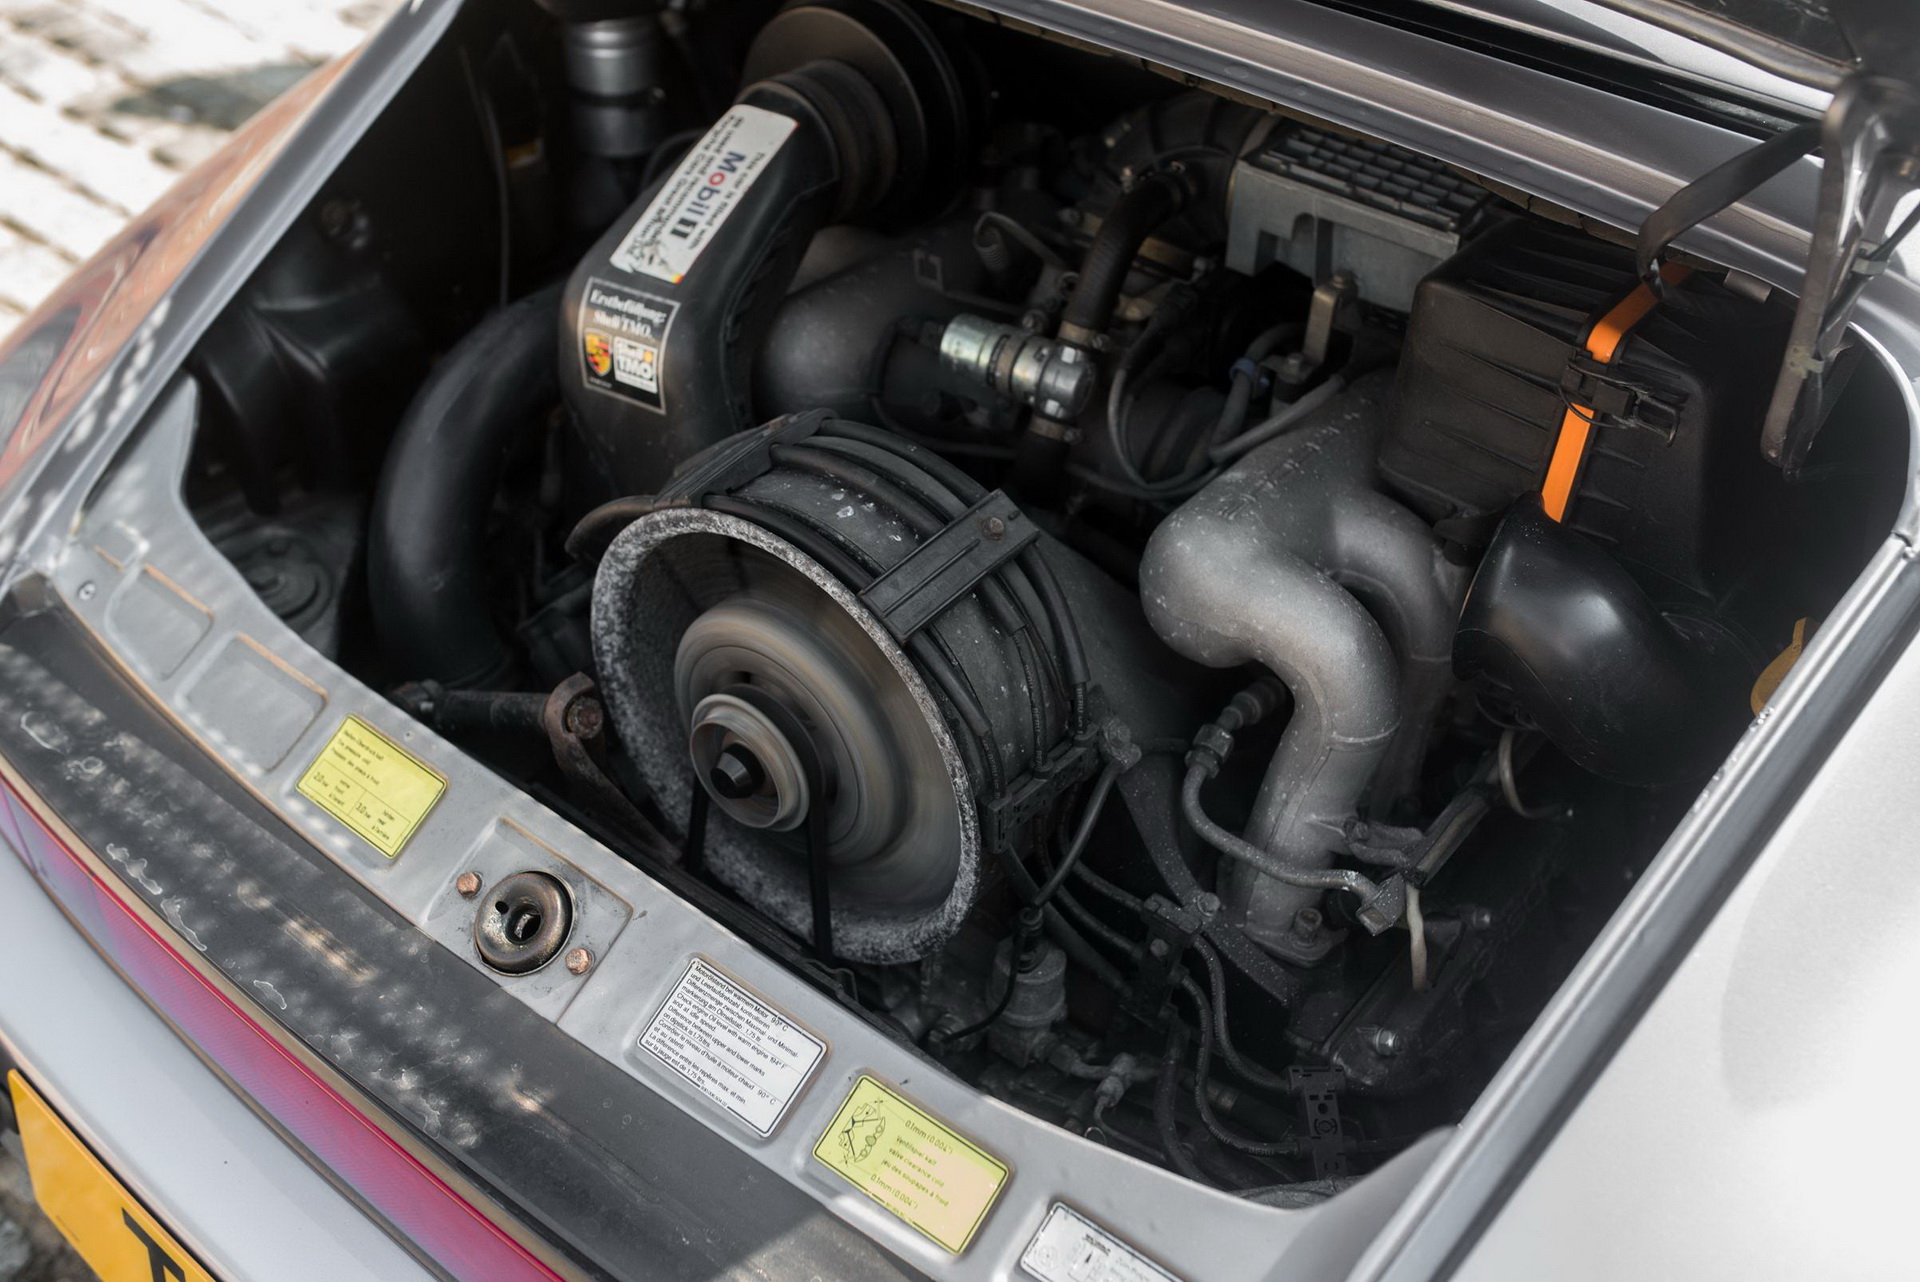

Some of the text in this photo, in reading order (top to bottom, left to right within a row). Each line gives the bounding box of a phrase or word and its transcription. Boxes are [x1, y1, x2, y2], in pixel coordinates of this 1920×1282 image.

[703, 114, 736, 151] Porsche
[714, 131, 734, 154] used
[698, 156, 716, 176] and
[733, 172, 749, 189] car
[669, 151, 747, 239] Mobil 1
[705, 202, 729, 226] filled
[688, 228, 707, 250] with
[617, 355, 652, 379] TMO
[681, 985, 709, 1008] markierung
[708, 1004, 717, 1012] am
[690, 973, 701, 982] und
[701, 979, 740, 1008] Leerlaufdrehzahl
[695, 965, 726, 989] Motorölstand
[725, 986, 734, 994] bei
[733, 993, 754, 1009] warmem
[754, 1006, 769, 1018] Motor
[782, 1024, 789, 1032] C
[672, 999, 684, 1009] and
[689, 1010, 700, 1020] idle
[686, 978, 723, 1007] Differenzmenge
[723, 1004, 745, 1022] zwischen
[767, 1035, 778, 1044] und
[777, 1041, 798, 1058] Minimal-
[668, 1005, 765, 1076] Difference between upper and lower marks
[669, 1017, 688, 1033] dipstick
[692, 1032, 704, 1042] 1,75
[677, 992, 692, 1006] Check
[692, 1004, 709, 1018] engine
[708, 1014, 717, 1022] Oil
[715, 1019, 728, 1030] level
[727, 1028, 738, 1038] with
[737, 1036, 752, 1047] warm
[751, 1045, 769, 1059] engine
[645, 1039, 654, 1047] sur
[657, 1048, 672, 1061] jauge
[671, 1058, 680, 1067] est
[649, 1032, 657, 1040] La
[679, 1054, 692, 1065] entre
[691, 1062, 700, 1071] les
[685, 1039, 702, 1053] niveau
[700, 1050, 718, 1064] d'huile
[720, 1064, 739, 1079] moteur
[738, 1076, 755, 1090] chaud
[769, 1097, 777, 1105] C
[888, 1148, 945, 1188] valve clearance cold
[924, 1155, 937, 1166] kalt
[881, 1159, 892, 1169] jeu
[891, 1165, 902, 1175] des
[935, 1193, 949, 1207] froid
